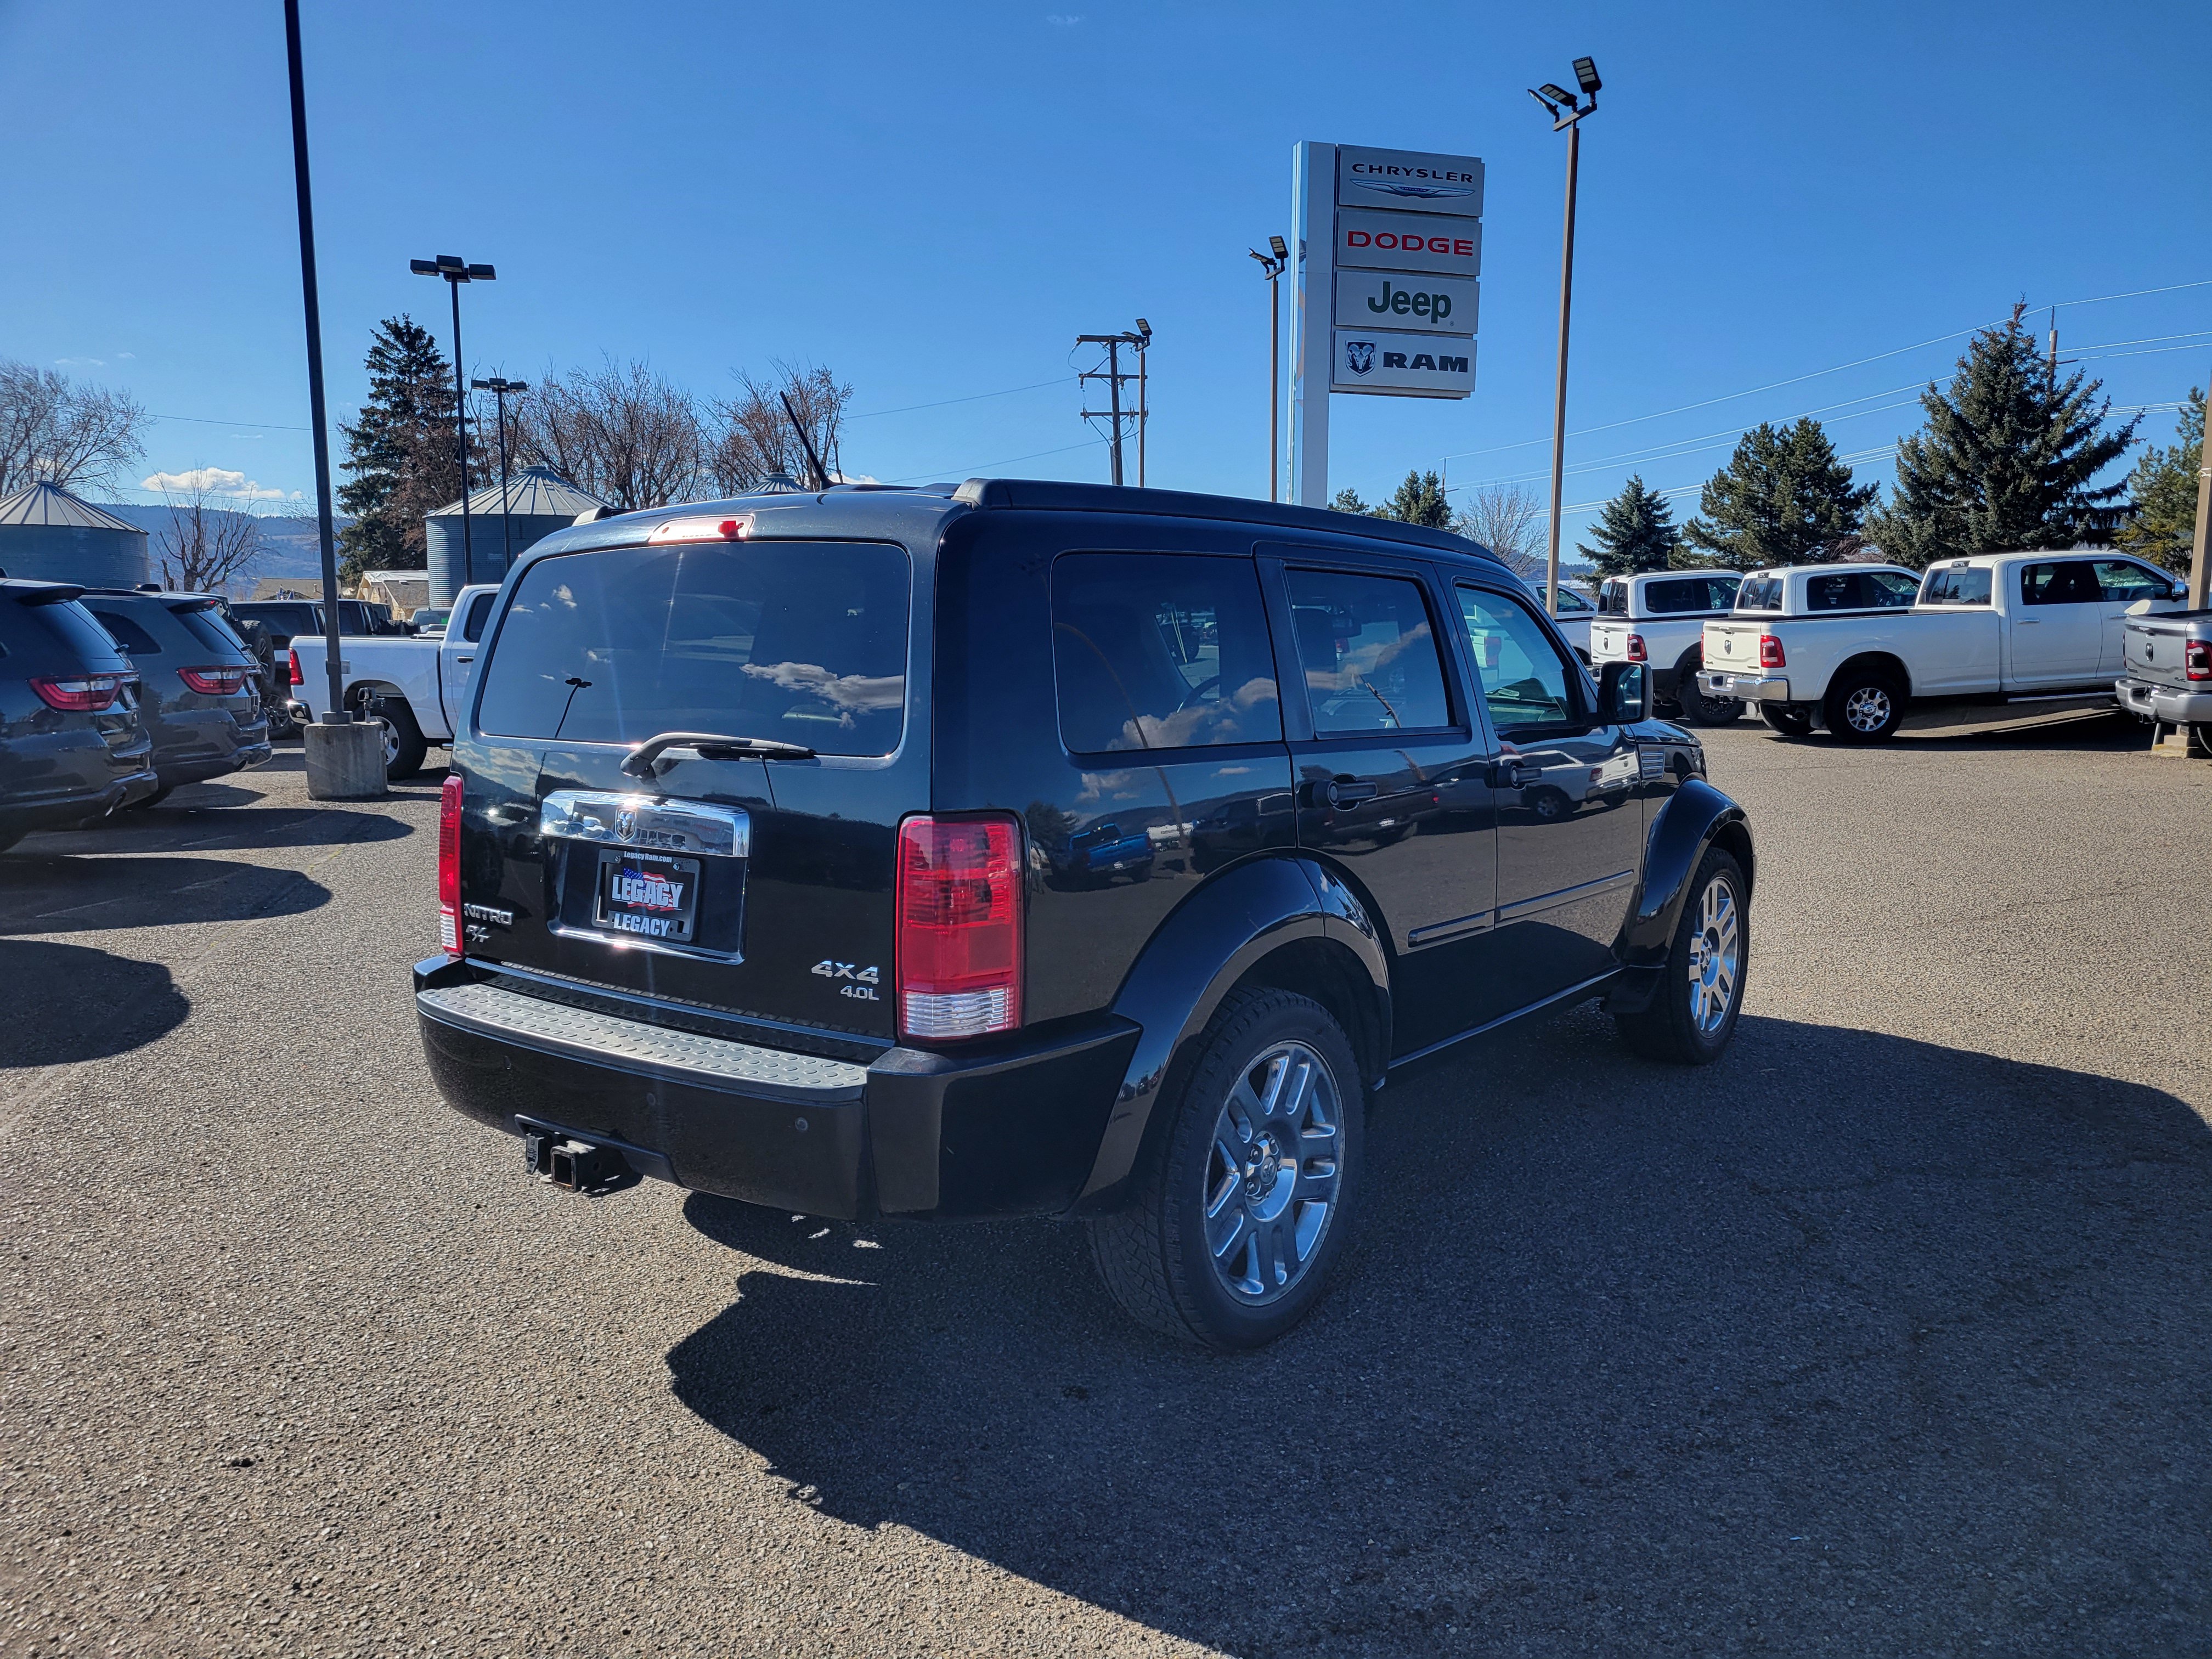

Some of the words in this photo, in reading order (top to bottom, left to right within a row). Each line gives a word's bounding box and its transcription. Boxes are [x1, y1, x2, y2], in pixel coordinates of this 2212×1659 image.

[1352, 163, 1473, 183] CHRYSLER
[1347, 231, 1474, 256] DODGE
[1367, 281, 1452, 324] Jeep
[1383, 352, 1469, 373] RAM
[612, 876, 683, 908] LEGACY
[464, 903, 514, 926] NITRO
[613, 913, 670, 936] LEGACY
[465, 925, 492, 943] R/T
[840, 985, 879, 1001] 4.0L
